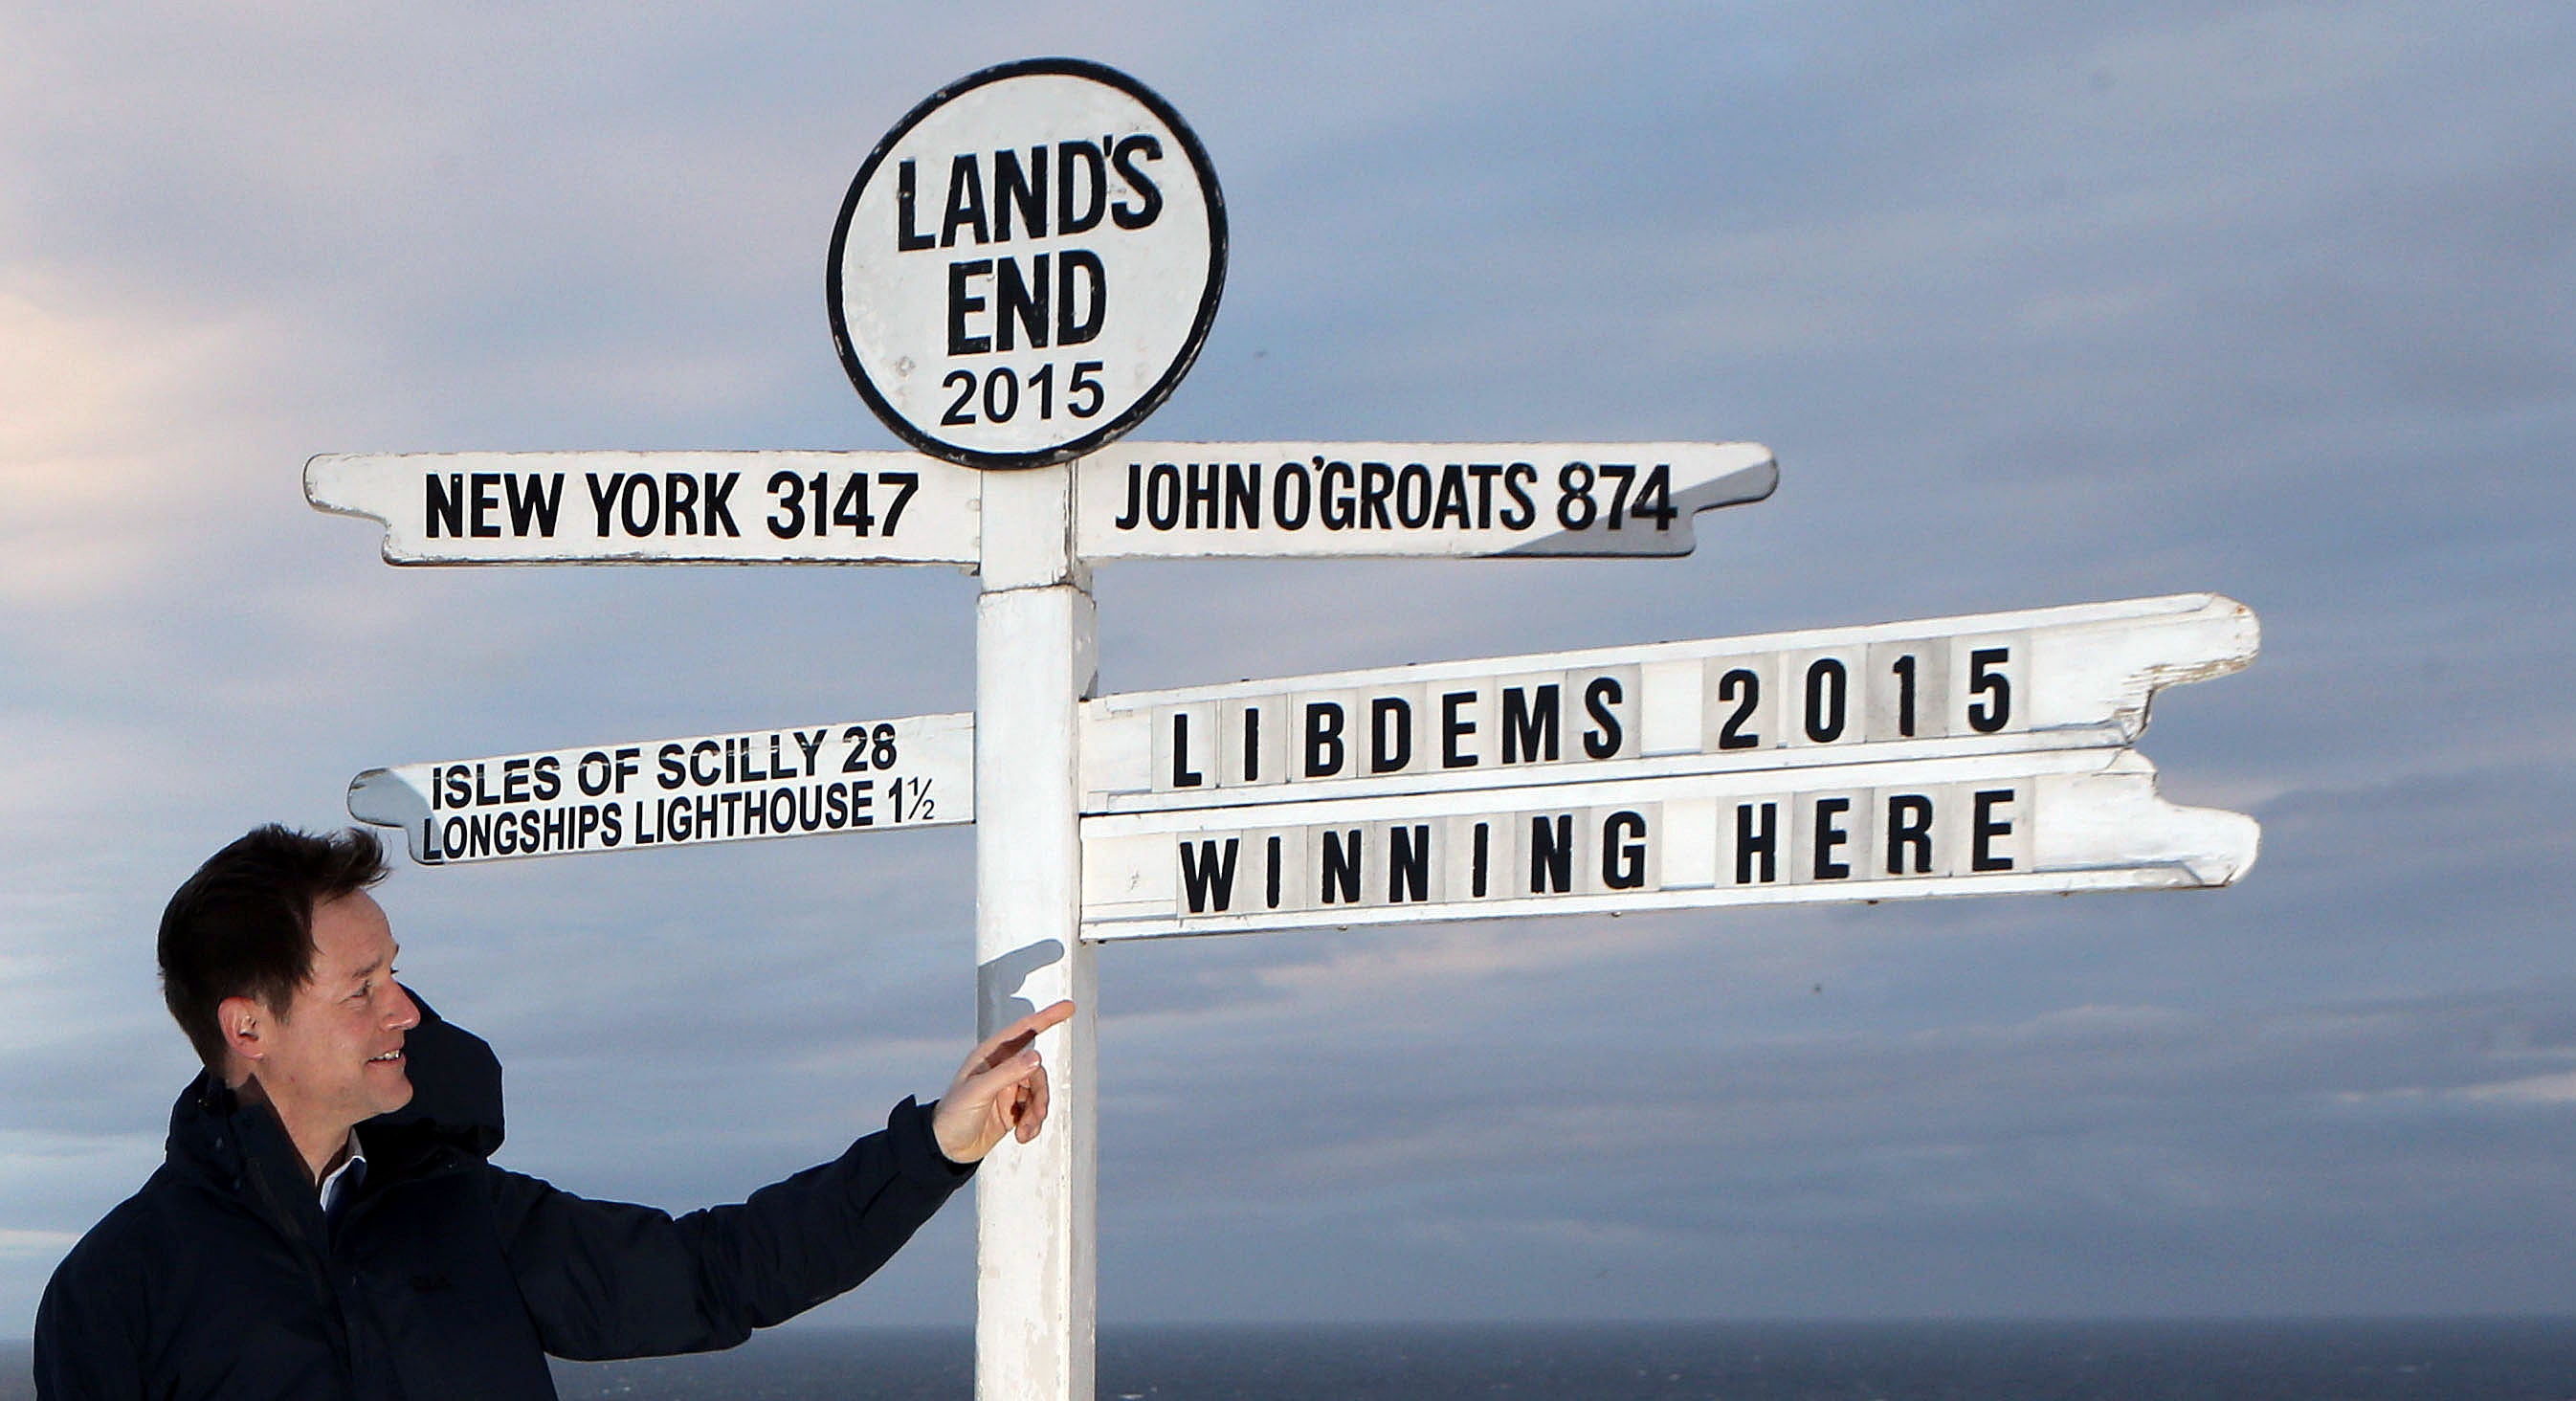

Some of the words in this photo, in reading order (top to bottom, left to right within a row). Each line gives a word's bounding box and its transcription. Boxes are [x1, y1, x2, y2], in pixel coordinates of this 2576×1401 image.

[898, 133, 1164, 252] LAND'S
[947, 249, 1107, 356] END
[941, 362, 1106, 426] 2015
[427, 473, 565, 539] NEW
[586, 473, 741, 538] YORK
[767, 471, 919, 540] 3147
[1116, 463, 1261, 531] JOHN
[1274, 456, 1538, 531] O'GROATS
[1558, 462, 1677, 532] 874
[1174, 678, 1621, 788] LIBDEMS
[1720, 649, 2010, 750] 2015
[433, 757, 562, 811] ISLES
[578, 748, 639, 796] OF
[657, 729, 828, 790] SCILLY
[842, 723, 898, 773] 28
[422, 802, 622, 860] LONGSHIPS
[636, 780, 874, 843] LIGHTHOUSE
[1179, 811, 1646, 913] WINNING
[1737, 789, 2014, 884] HERE
